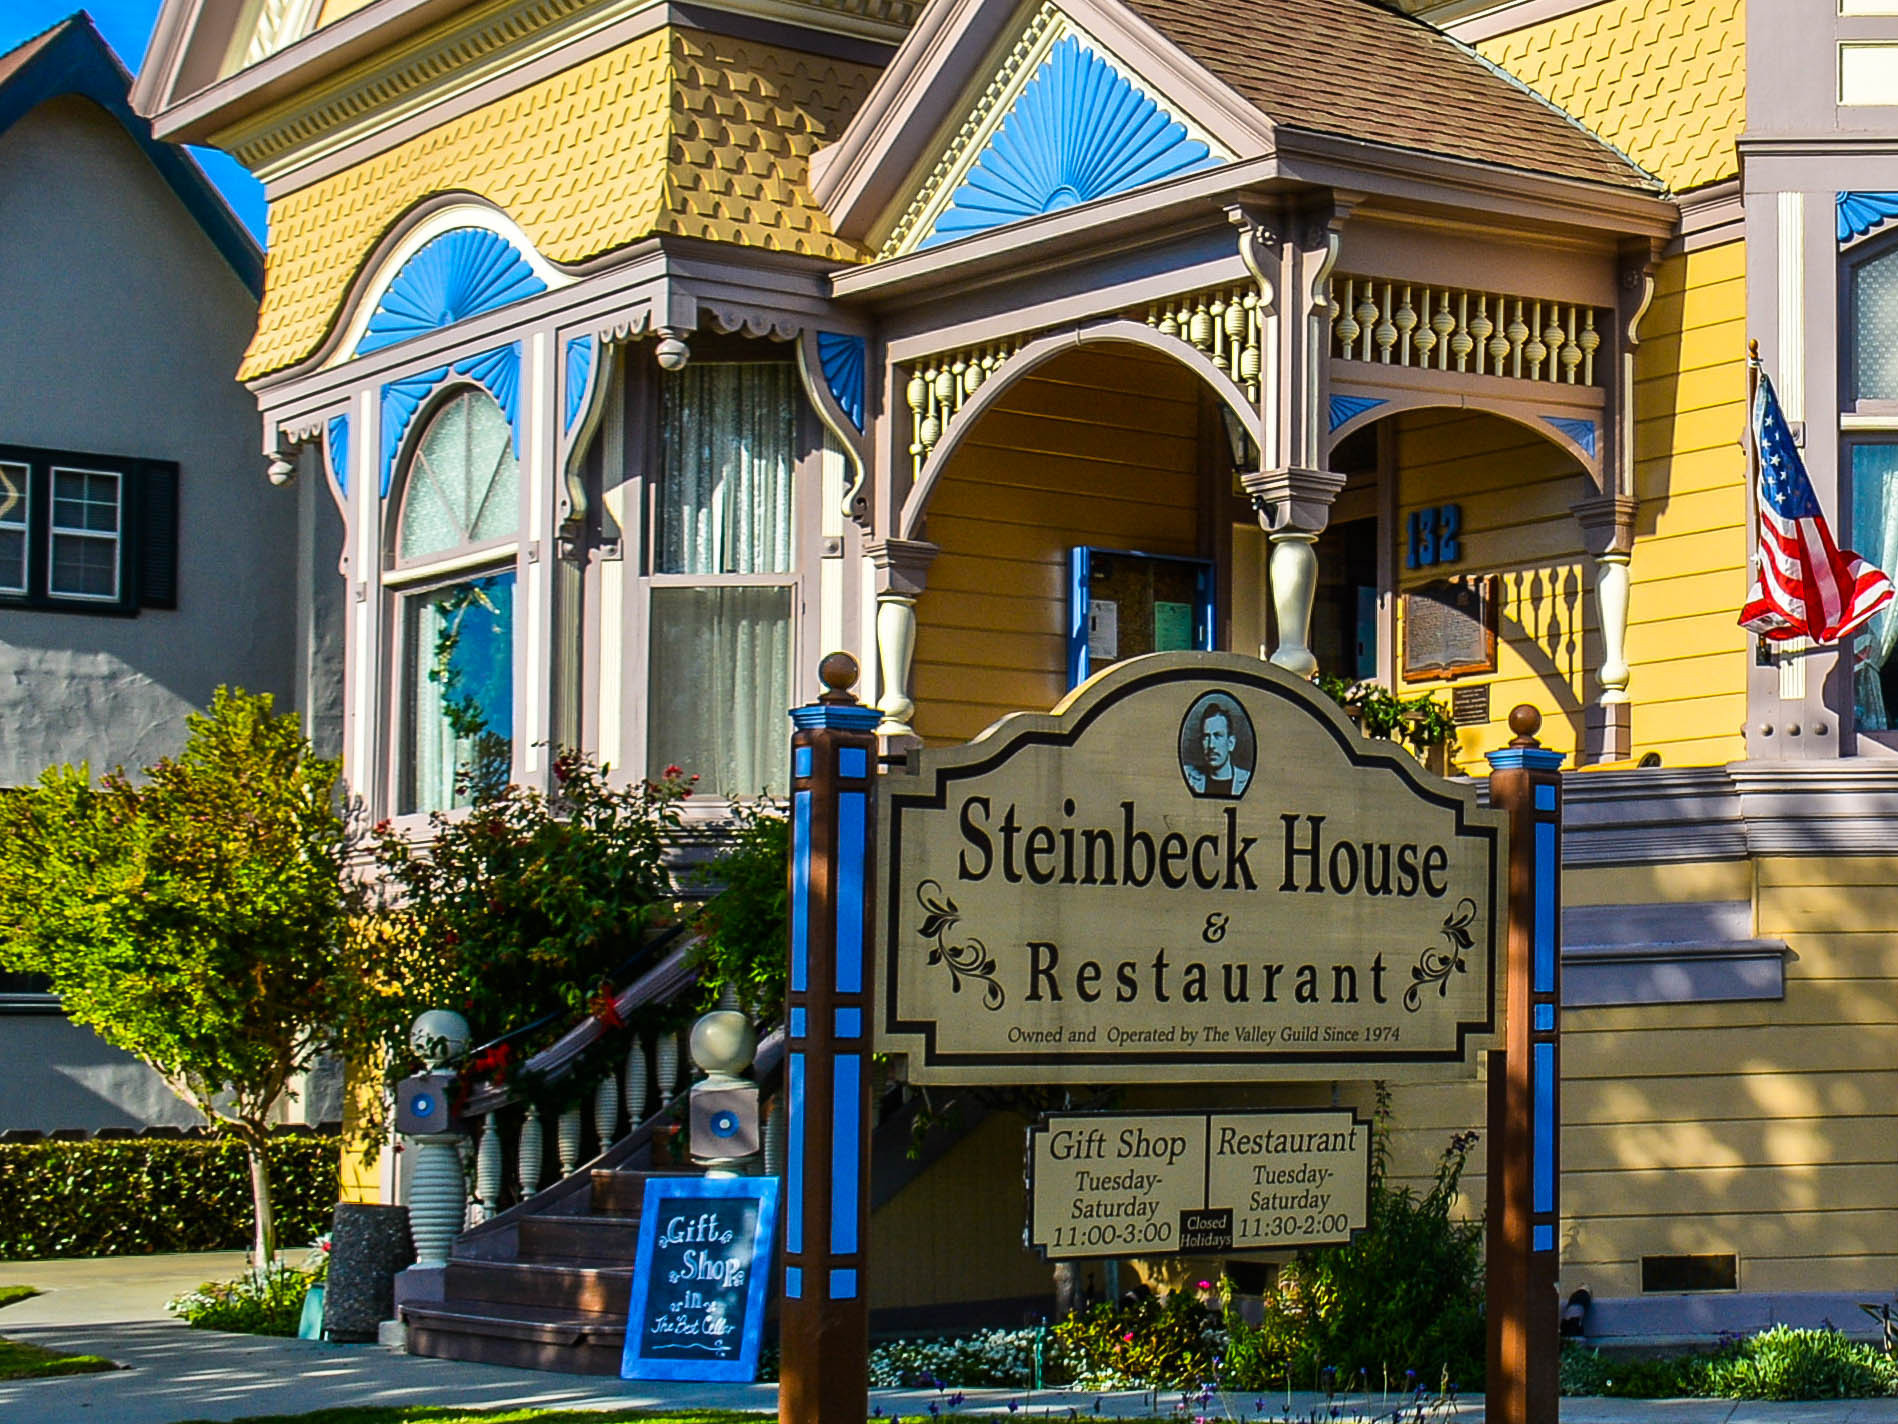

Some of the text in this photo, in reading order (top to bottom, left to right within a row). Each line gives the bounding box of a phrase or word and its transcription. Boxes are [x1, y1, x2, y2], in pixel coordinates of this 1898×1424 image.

[1406, 505, 1461, 568] 132
[958, 795, 1448, 898] Steinbeck House
[1202, 911, 1230, 943] &
[1025, 941, 1388, 1004] Restaurant
[1008, 1026, 1401, 1047] Owned and Operated by The Valley Guild Since 1974
[1050, 1128, 1187, 1166] Gift Shop
[1217, 1127, 1357, 1156] Restaurant
[1075, 1169, 1163, 1195] Tuesday-
[1253, 1163, 1334, 1188] Tuesday-
[1071, 1196, 1160, 1221] Saturday
[1249, 1189, 1331, 1214] Saturday
[667, 1213, 720, 1244] Gift
[1053, 1222, 1172, 1247] 11:00-3:00
[1186, 1216, 1227, 1231] Closed
[1239, 1213, 1349, 1238] 11:30-2:00
[1180, 1234, 1232, 1250] Holidays
[681, 1249, 741, 1288] Shop
[684, 1290, 702, 1309] in
[651, 1315, 674, 1334] The
